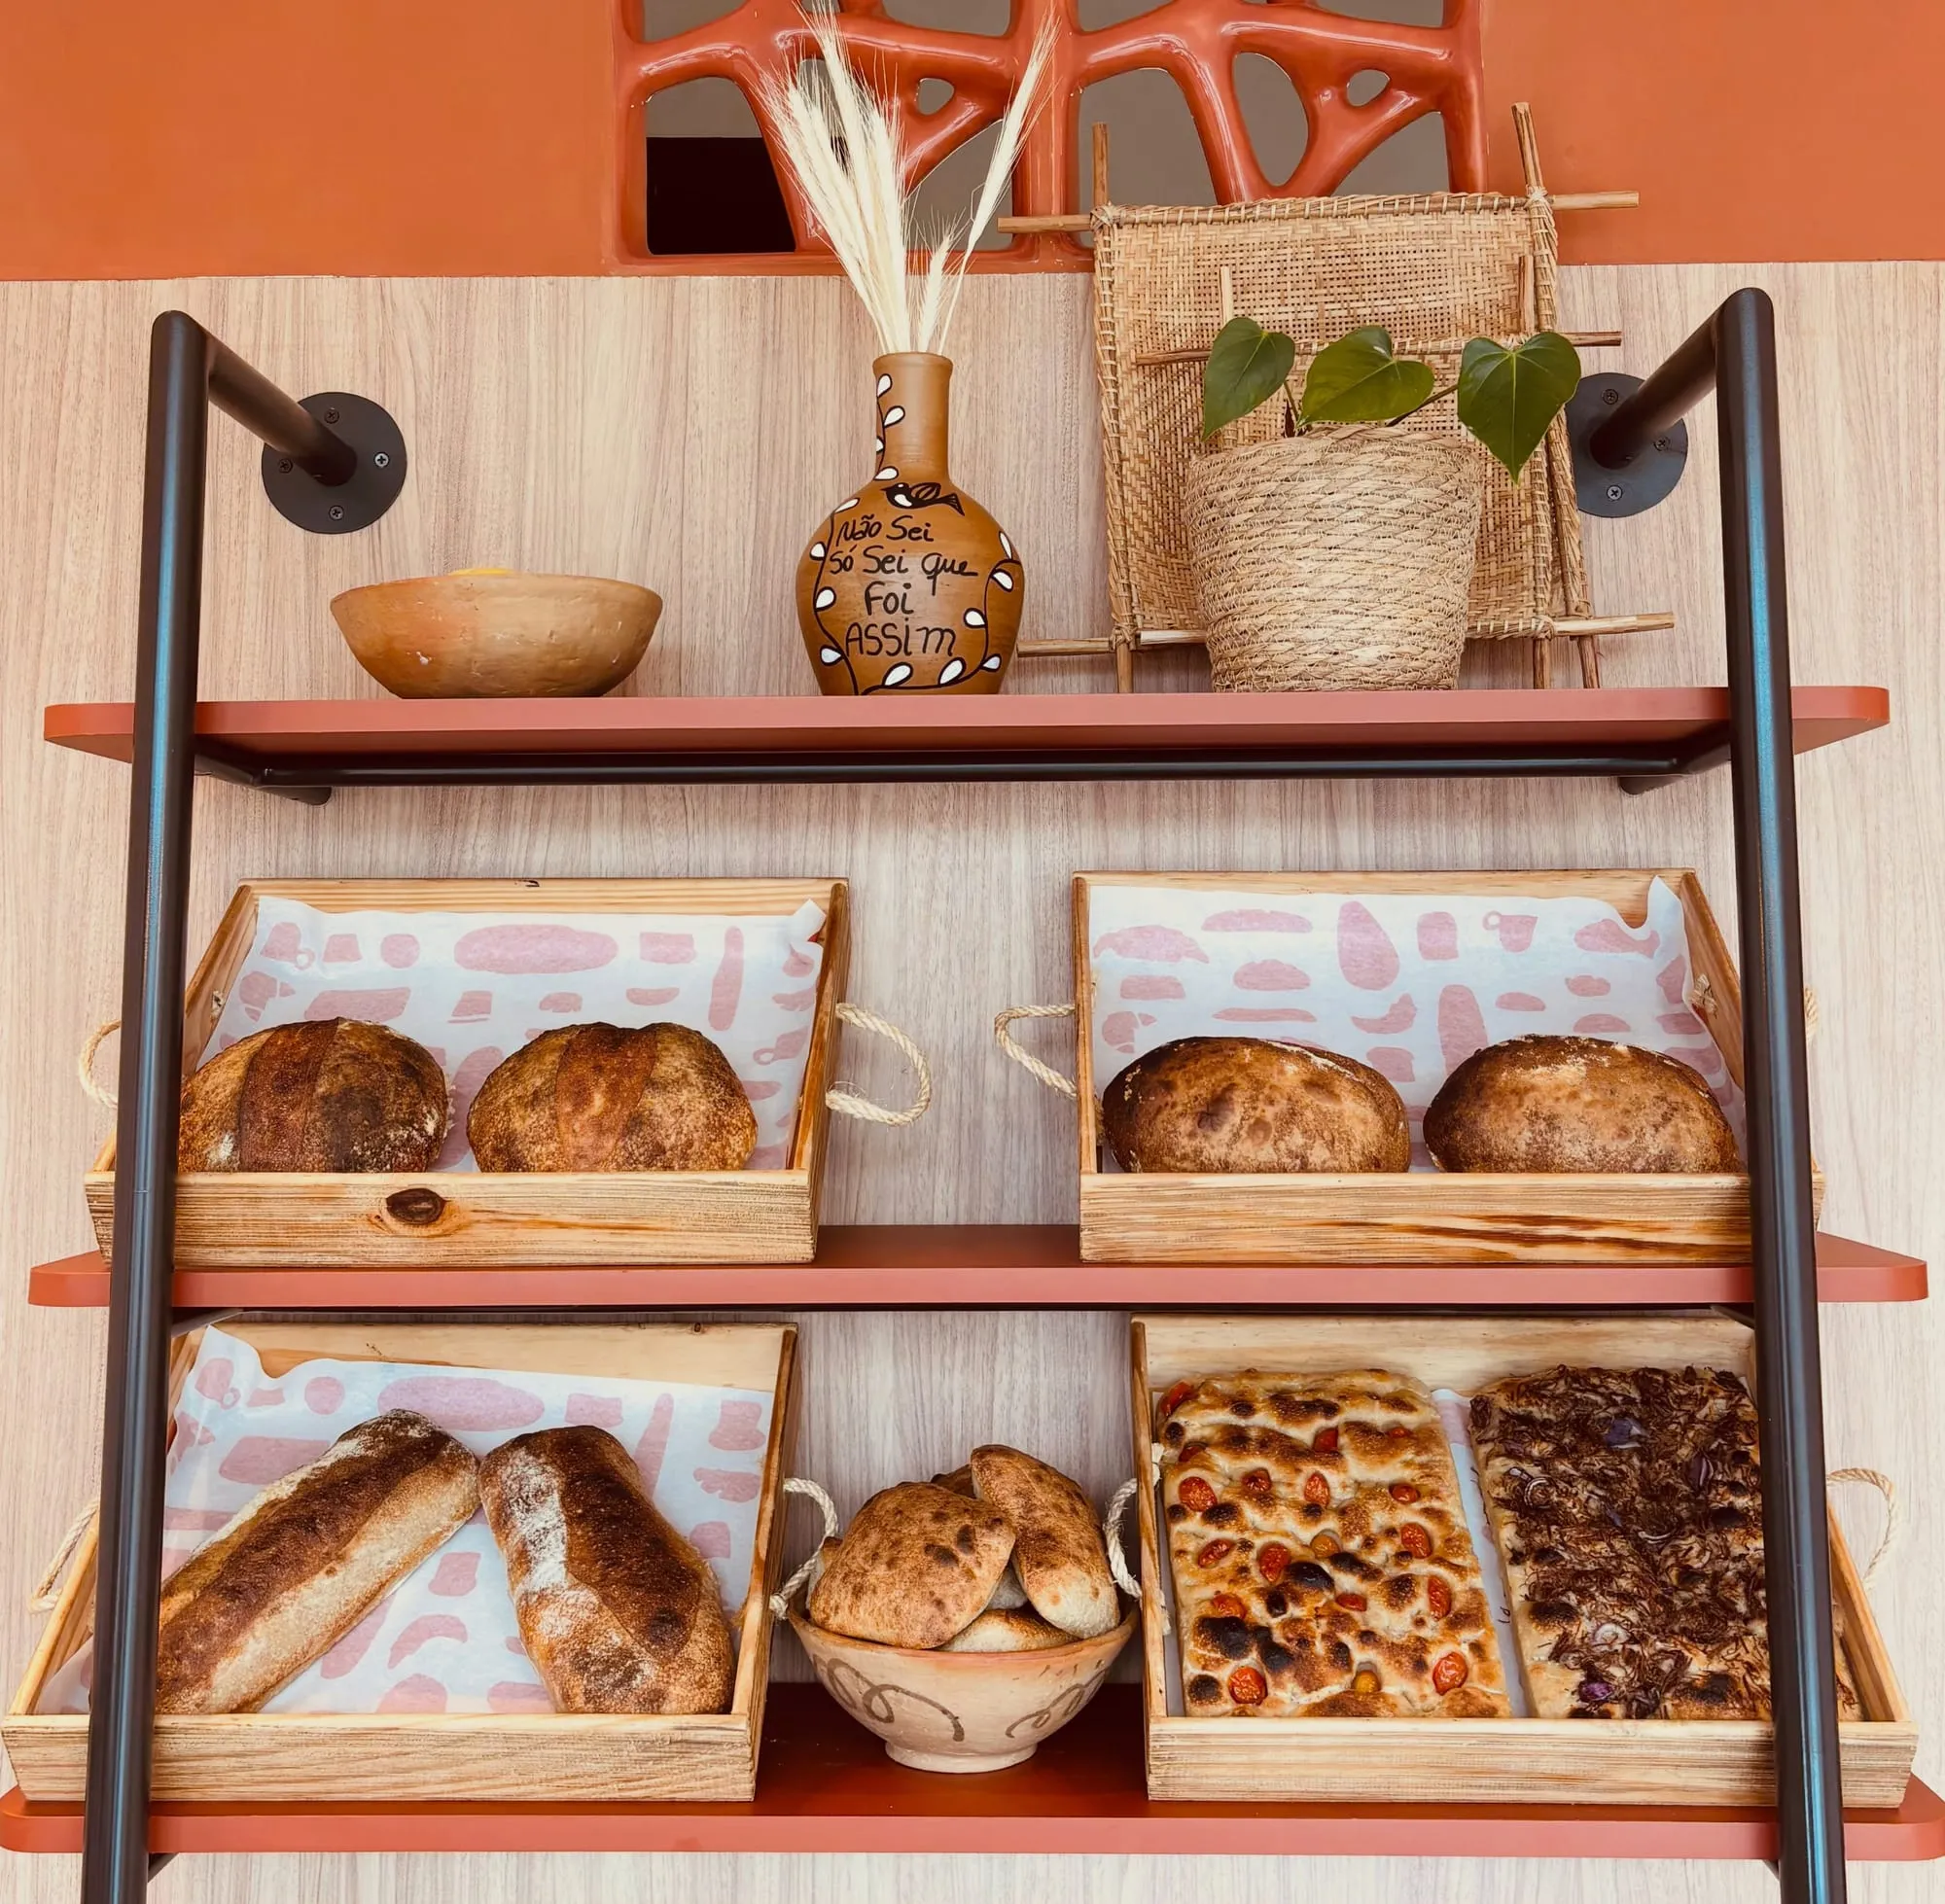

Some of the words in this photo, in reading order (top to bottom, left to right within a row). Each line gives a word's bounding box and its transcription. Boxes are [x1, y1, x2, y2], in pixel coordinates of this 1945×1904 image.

[835, 514, 882, 547] Não
[886, 515, 934, 542] Sei
[830, 545, 857, 575] Só
[863, 546, 908, 574] Sei
[921, 552, 978, 596] que
[865, 582, 914, 616] Foi
